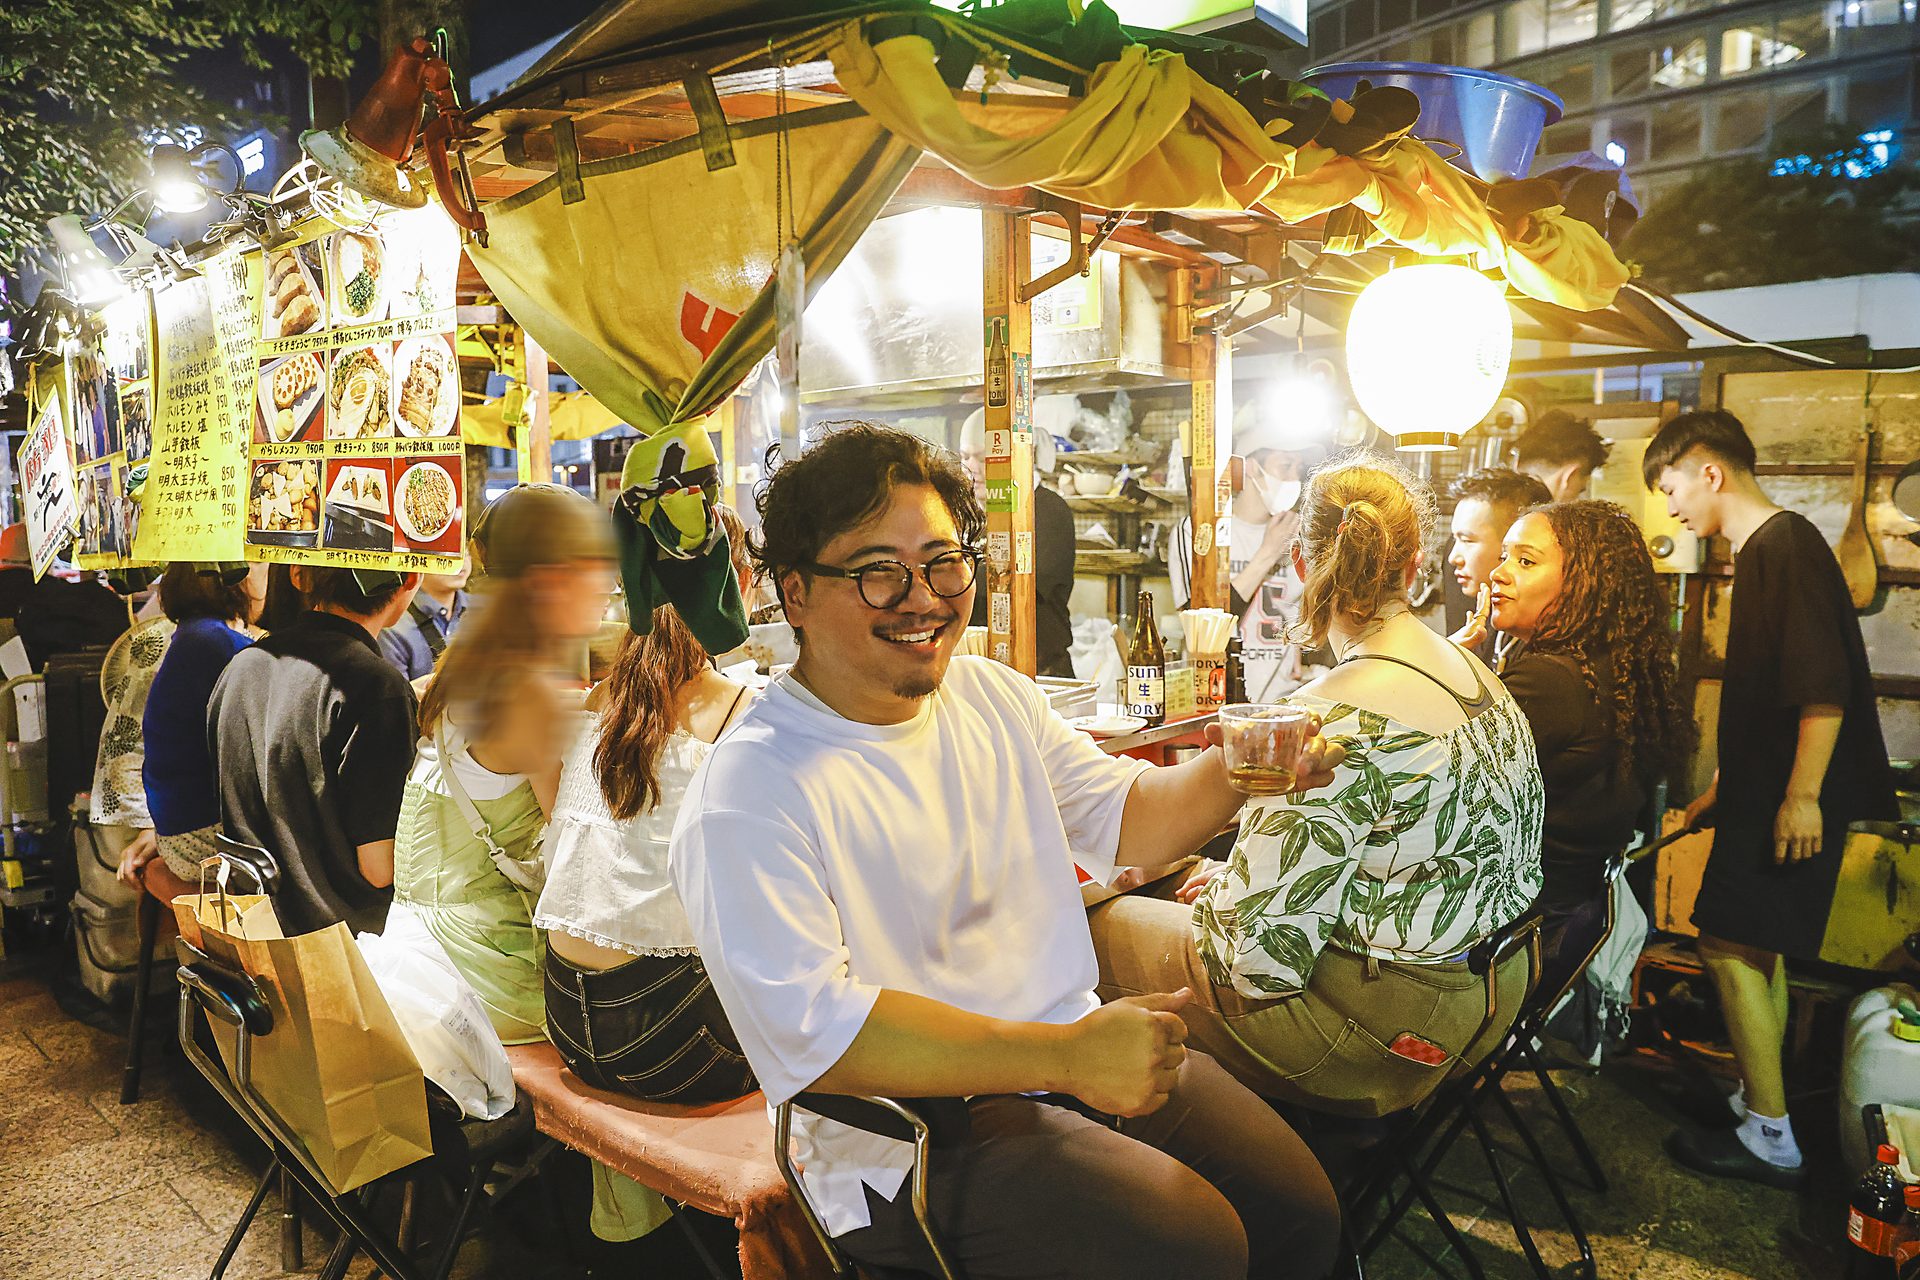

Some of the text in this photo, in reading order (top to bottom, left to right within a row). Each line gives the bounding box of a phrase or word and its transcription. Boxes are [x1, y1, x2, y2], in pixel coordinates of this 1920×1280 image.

[220, 431, 233, 445] 750
[305, 443, 324, 454] 750円
[334, 442, 366, 454] 焼きラーメン
[221, 466, 235, 481] 850
[221, 484, 236, 498] 700
[221, 503, 236, 517] 750
[1138, 682, 1150, 697] 生
